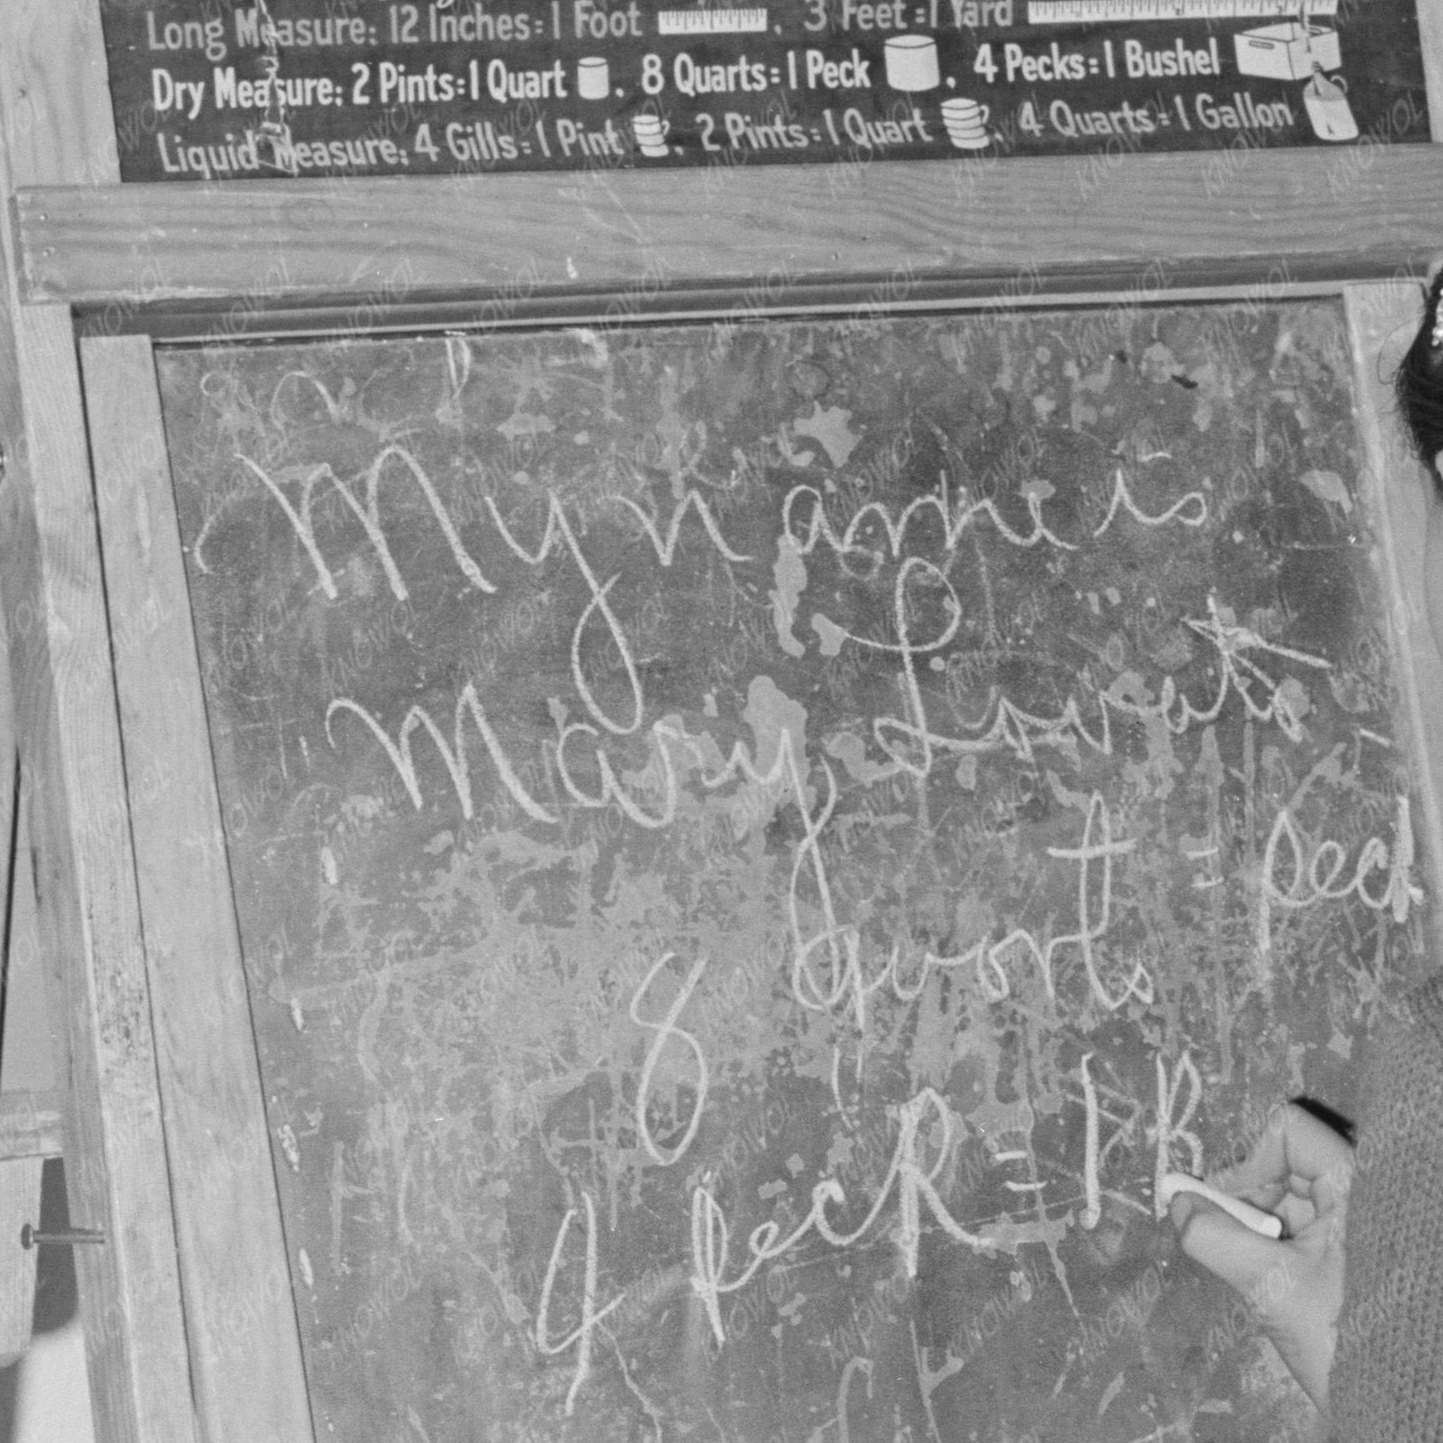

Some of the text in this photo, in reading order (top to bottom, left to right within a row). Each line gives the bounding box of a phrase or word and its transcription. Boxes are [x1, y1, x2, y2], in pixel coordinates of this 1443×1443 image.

[147, 9, 227, 62] Long
[389, 3, 419, 44] 12
[574, 0, 643, 38] Foot
[641, 53, 665, 95] 8
[806, 48, 871, 89] Peck
[973, 43, 998, 83] 4
[1124, 37, 1220, 78] Bushel
[152, 68, 205, 121] Dry
[351, 62, 371, 105] 2
[487, 59, 568, 104] Quart
[695, 113, 721, 152] 2
[843, 108, 933, 149] Quart
[1019, 101, 1045, 138] 4
[1195, 92, 1295, 131] Gallon
[157, 130, 259, 180] Liquid
[414, 123, 440, 162] 4
[556, 118, 625, 157] Pint
